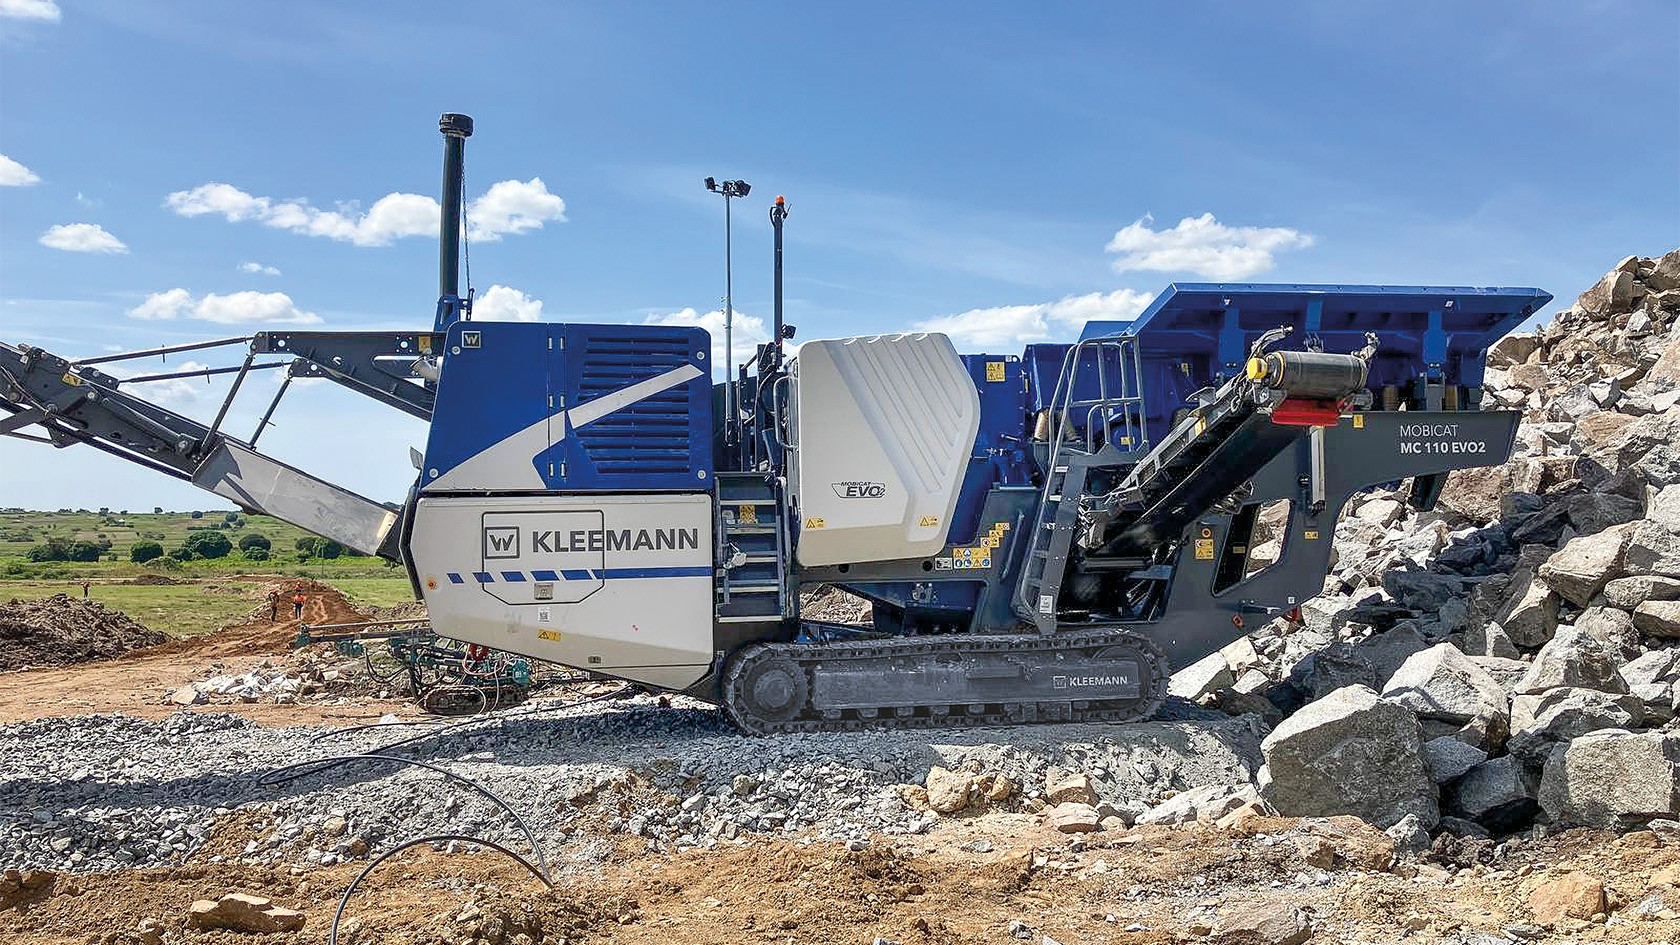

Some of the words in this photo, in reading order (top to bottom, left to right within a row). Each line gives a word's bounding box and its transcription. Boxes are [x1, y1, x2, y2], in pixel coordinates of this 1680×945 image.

[1400, 424, 1458, 437] MOBICAT
[1400, 442, 1421, 454] MC
[1424, 442, 1449, 454] 110
[1451, 441, 1486, 453] EVO2
[532, 528, 698, 553] KLEEMANN
[1069, 676, 1128, 687] KLEEMANN
